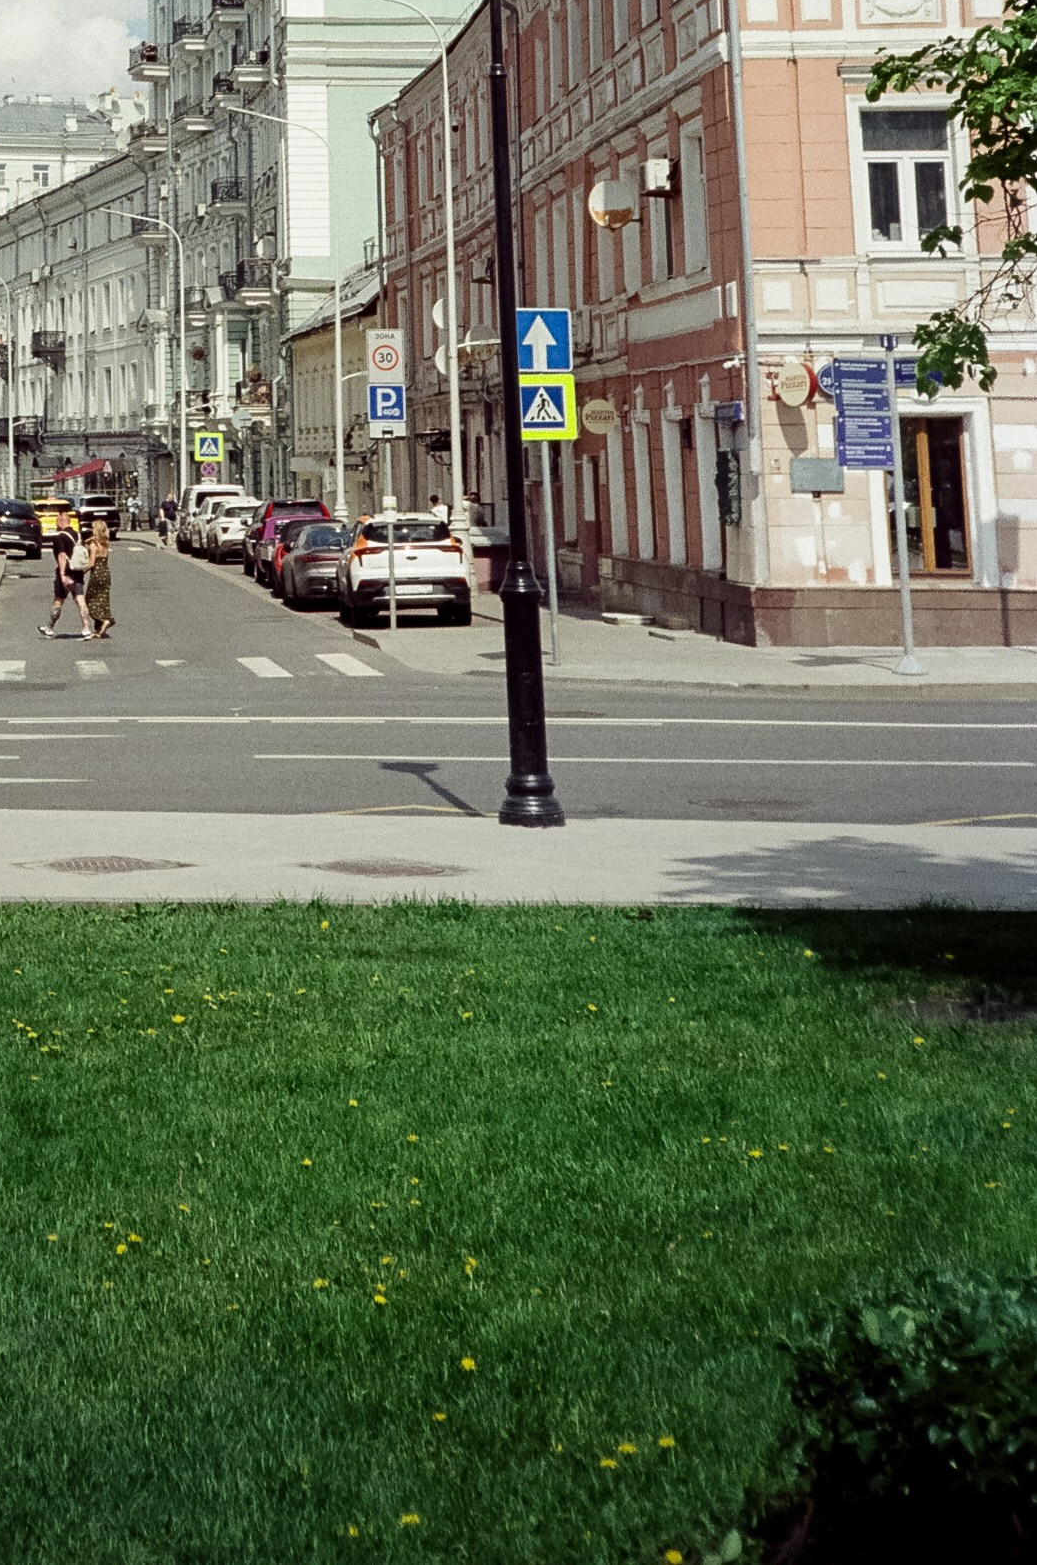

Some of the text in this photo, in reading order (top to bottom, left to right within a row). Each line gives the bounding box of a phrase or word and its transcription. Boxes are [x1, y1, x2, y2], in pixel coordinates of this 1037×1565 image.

[374, 332, 395, 340] ЗОНА
[378, 353, 393, 363] 30
[376, 388, 397, 417] P
